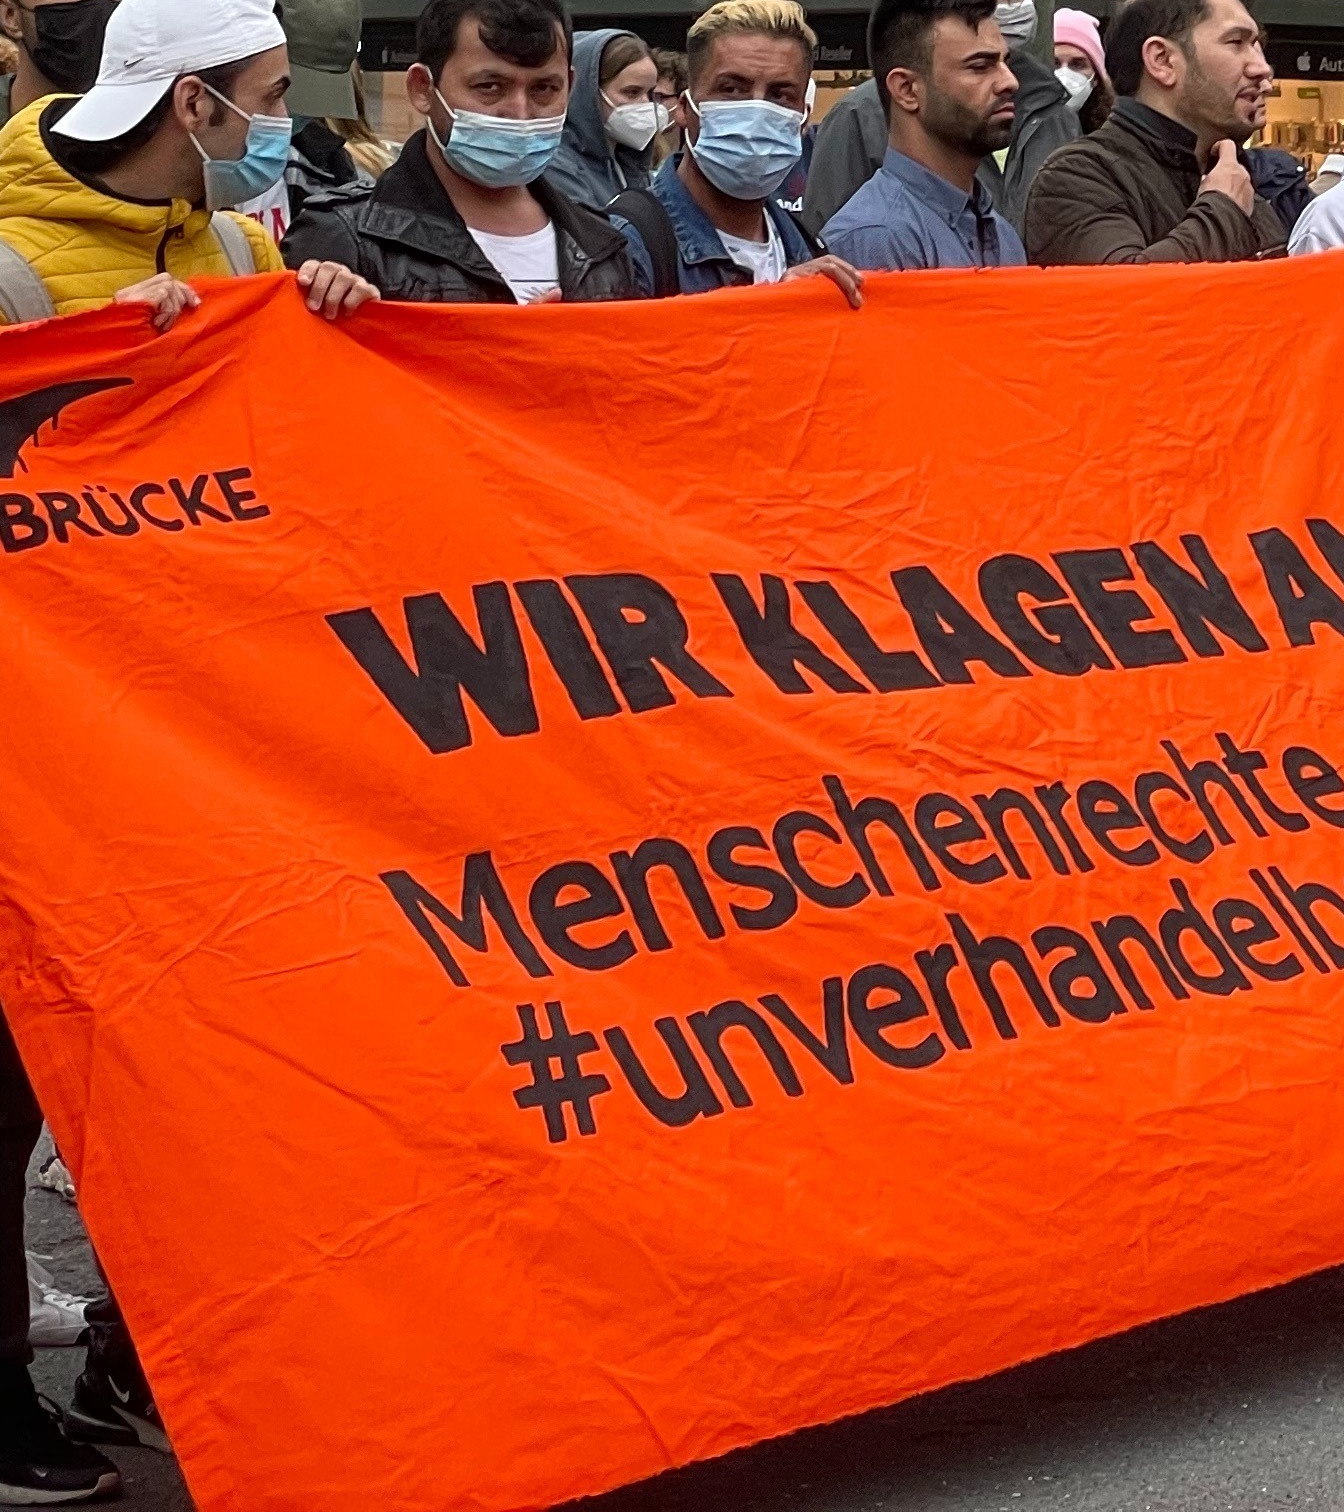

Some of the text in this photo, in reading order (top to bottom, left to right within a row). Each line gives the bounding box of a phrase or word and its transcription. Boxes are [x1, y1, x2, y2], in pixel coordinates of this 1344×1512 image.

[0, 467, 271, 553] BRÜCKE
[325, 573, 733, 754] WIR
[710, 535, 1269, 695] KLAGEN
